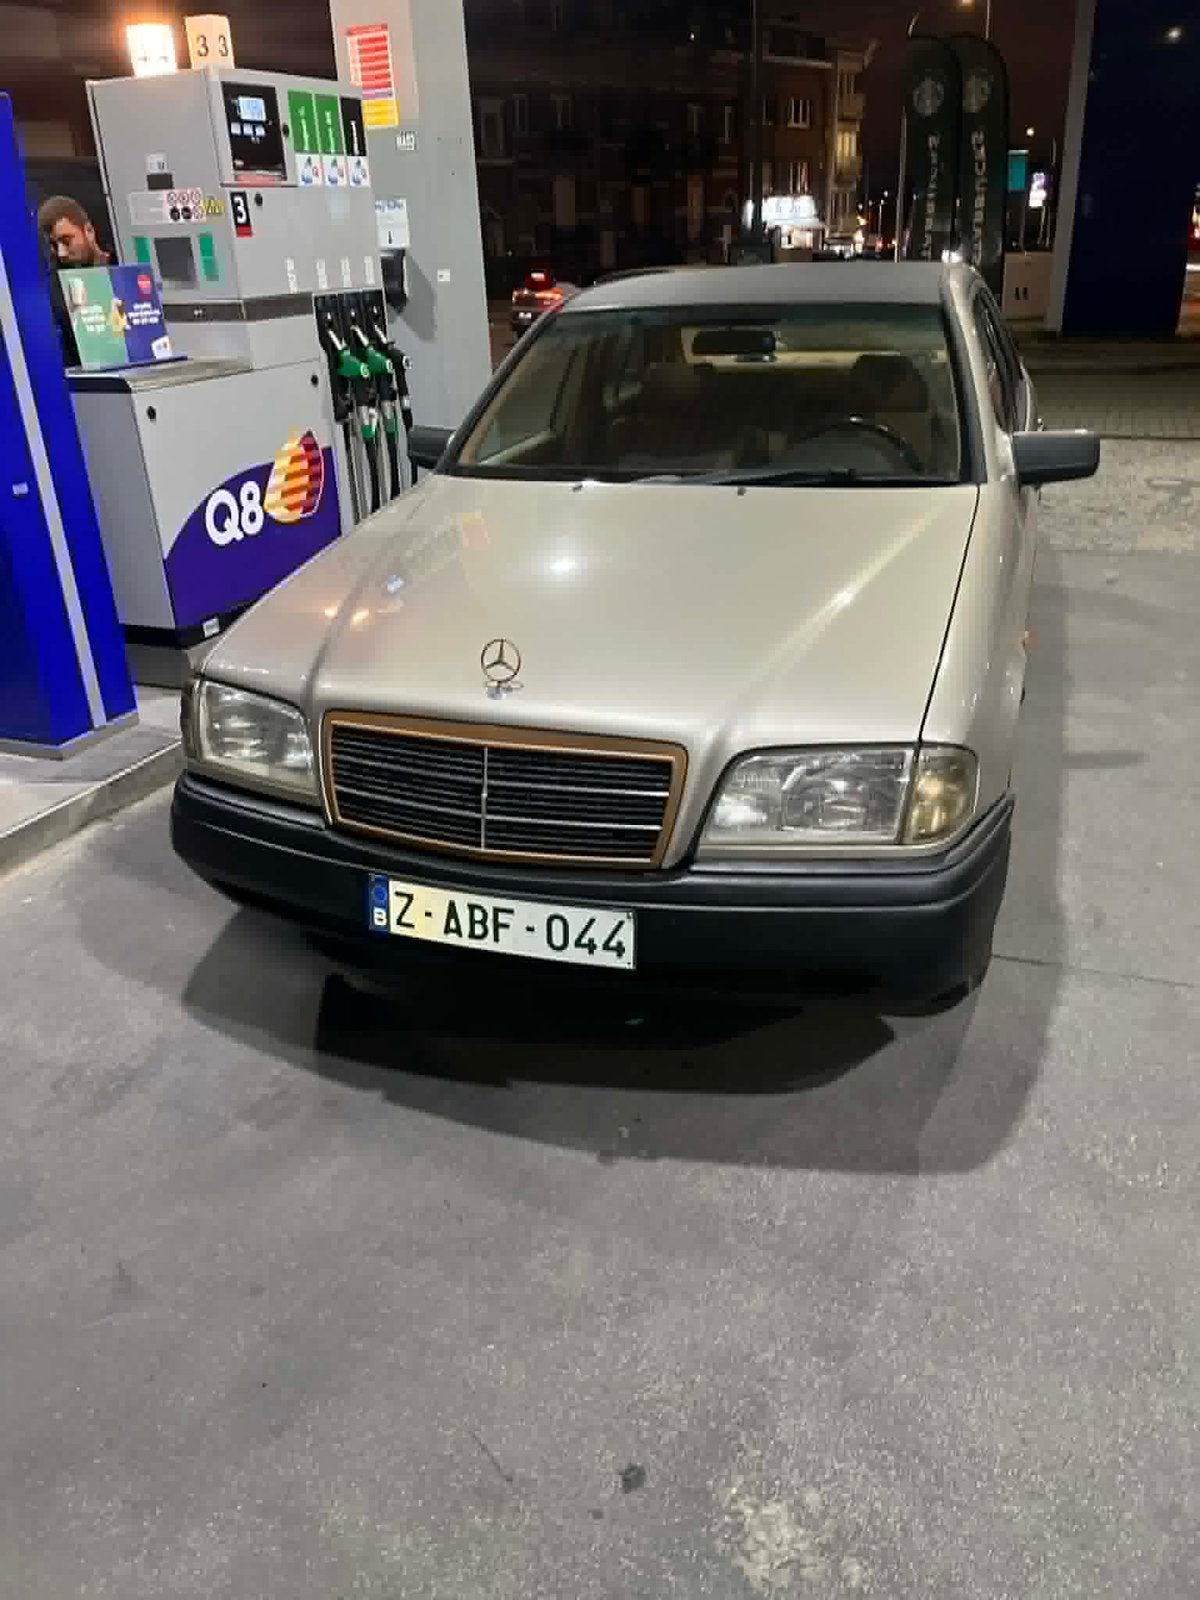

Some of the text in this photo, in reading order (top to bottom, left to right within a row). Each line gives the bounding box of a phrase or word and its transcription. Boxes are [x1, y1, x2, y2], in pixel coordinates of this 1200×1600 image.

[197, 35, 209, 57] 3
[219, 35, 229, 57] 3
[233, 195, 248, 224] 3
[205, 480, 265, 546] Q8
